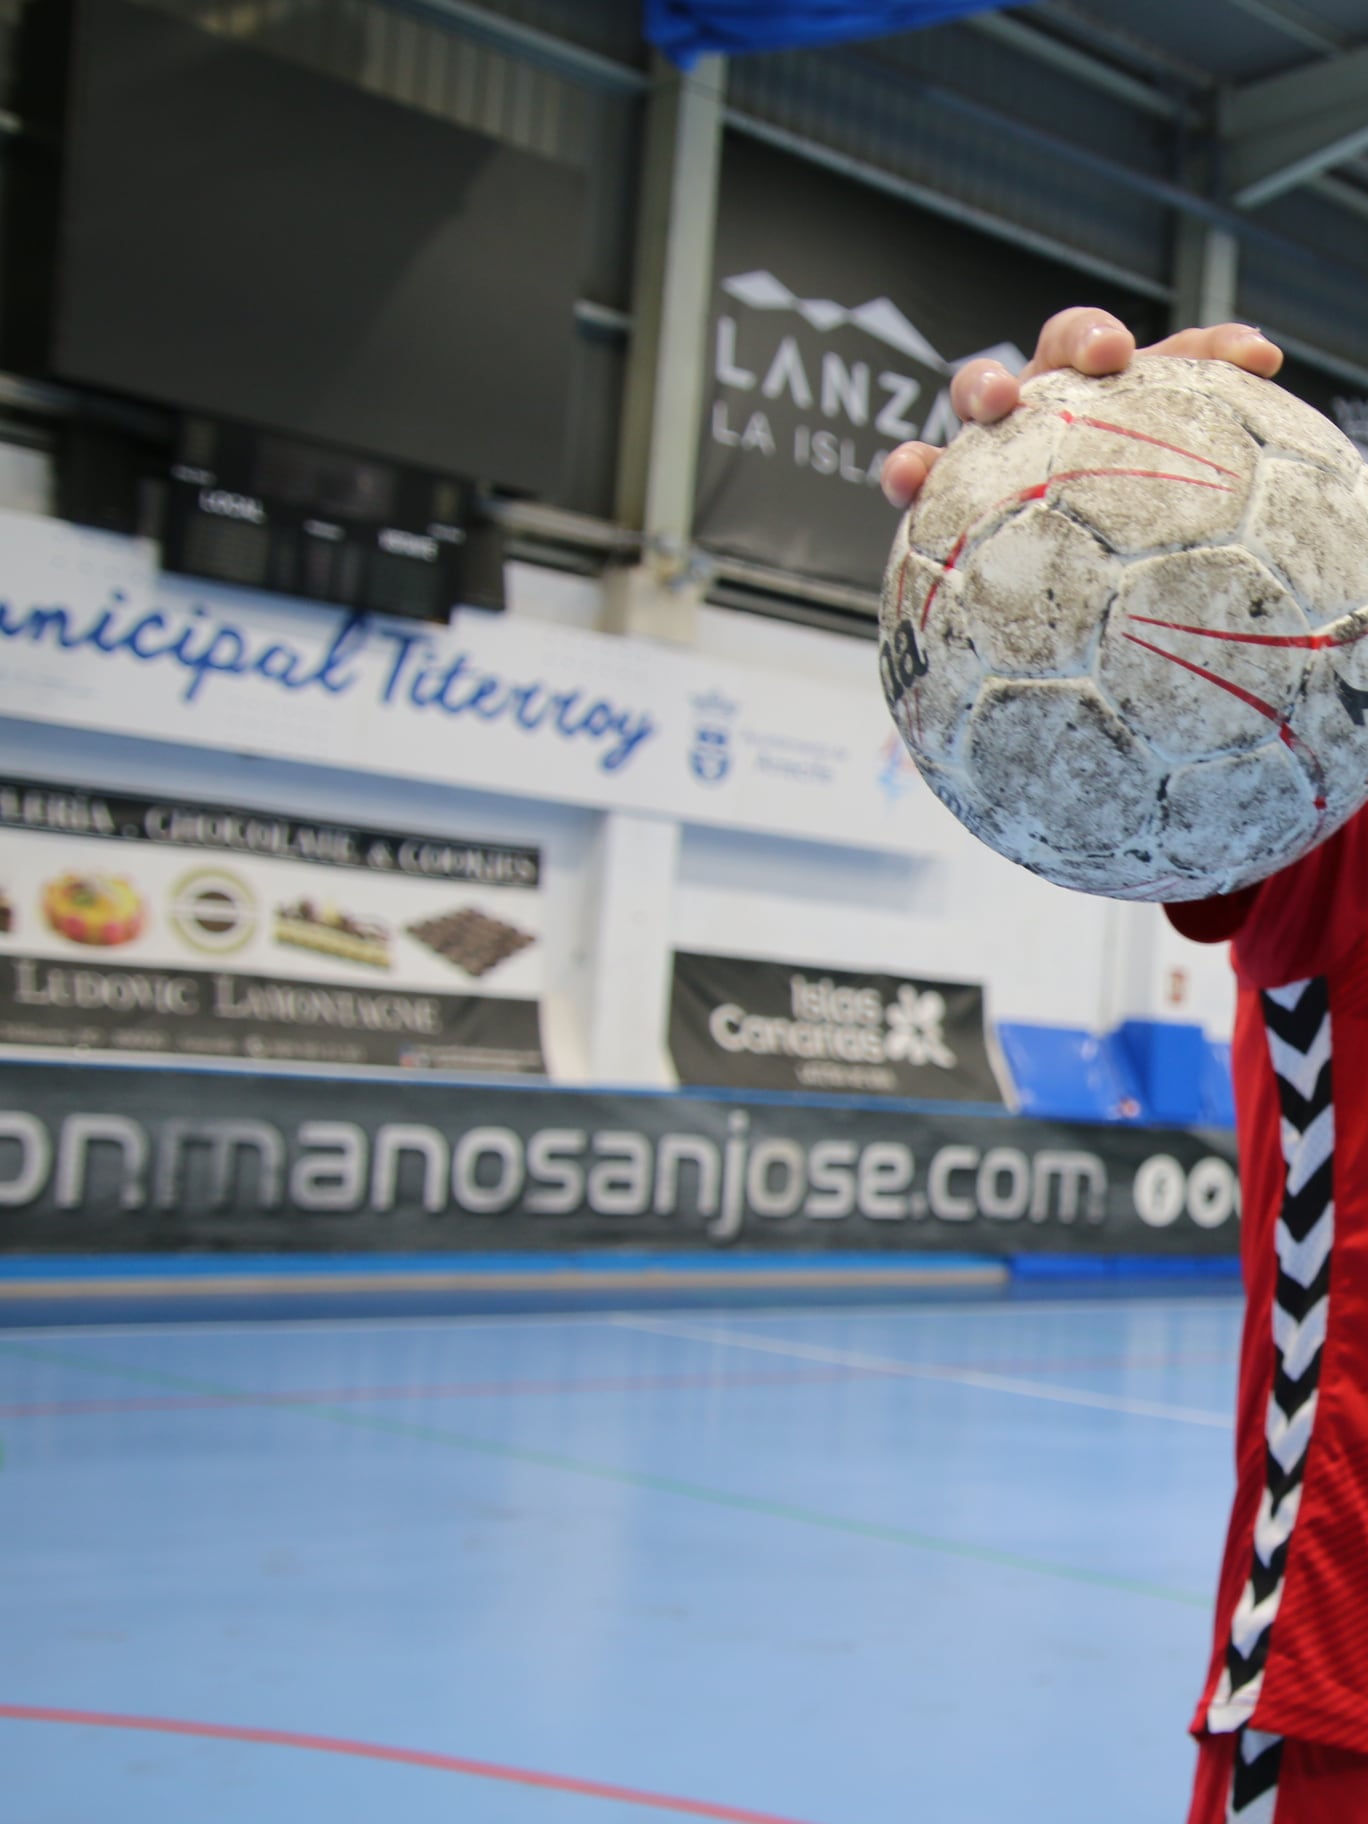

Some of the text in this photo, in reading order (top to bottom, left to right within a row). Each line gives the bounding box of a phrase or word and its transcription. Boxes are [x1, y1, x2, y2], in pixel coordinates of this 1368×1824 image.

[712, 400, 777, 457] LA
[374, 627, 657, 772] Titerroy
[15, 956, 197, 1016] LUDOVIC
[790, 973, 883, 1027] Islas
[708, 1002, 886, 1064] Canarias
